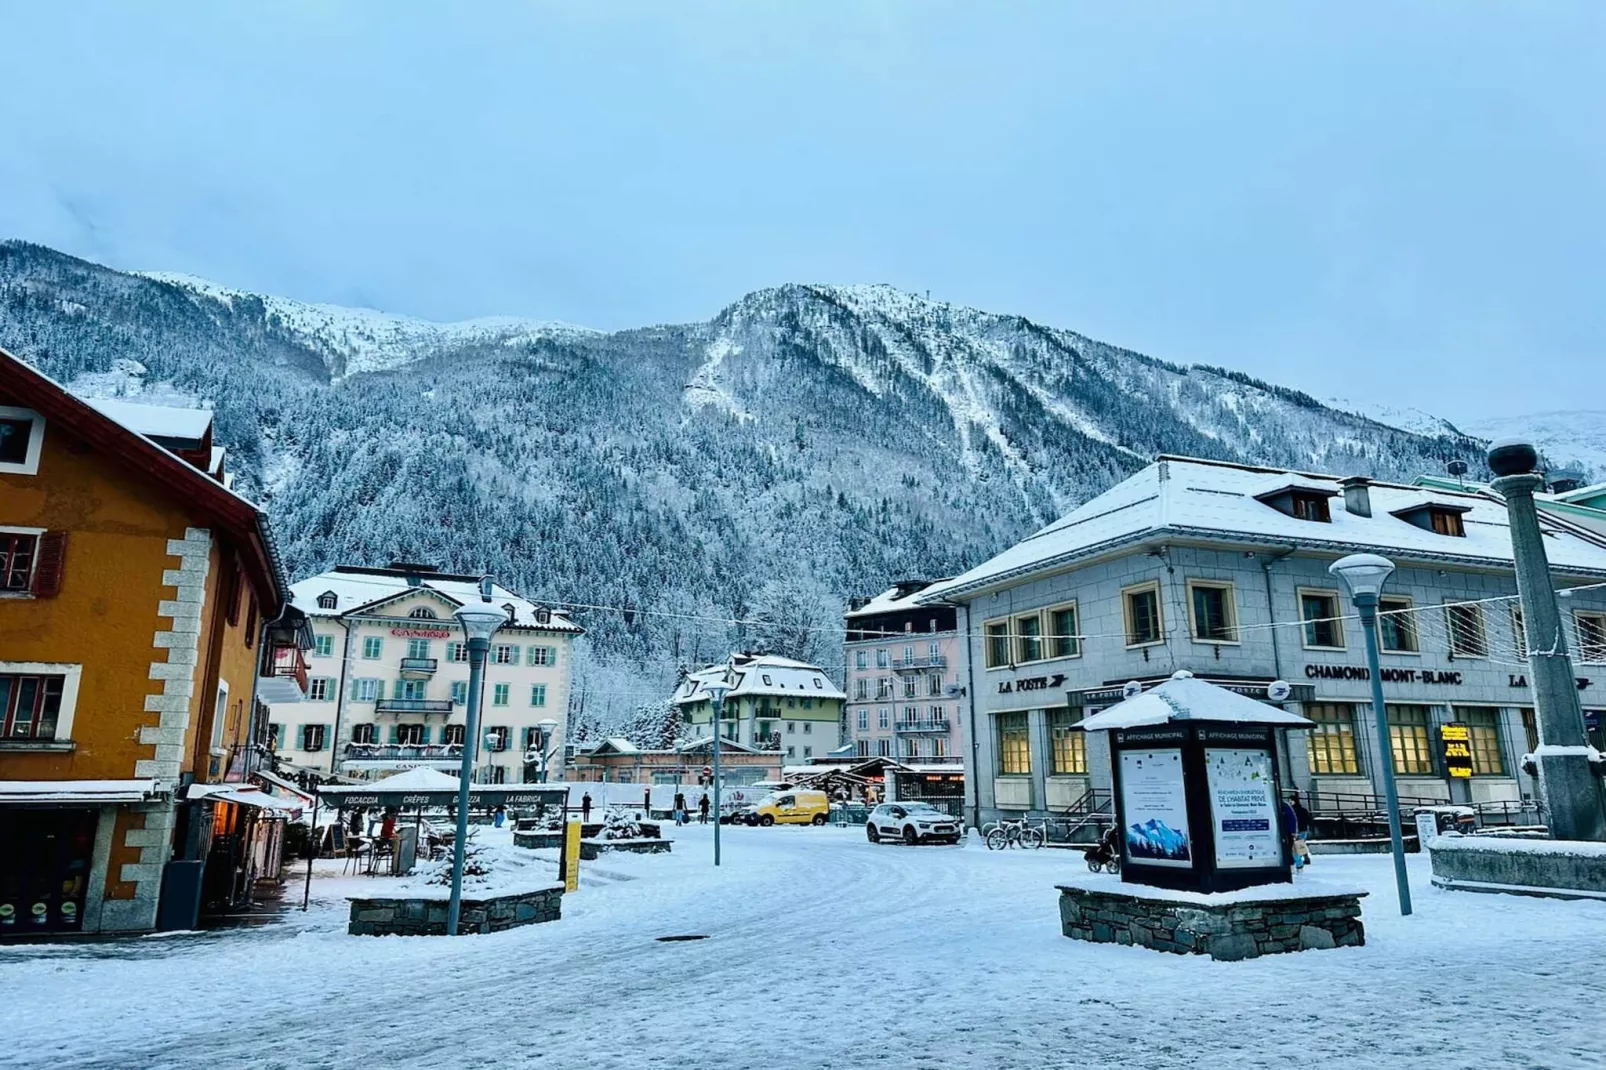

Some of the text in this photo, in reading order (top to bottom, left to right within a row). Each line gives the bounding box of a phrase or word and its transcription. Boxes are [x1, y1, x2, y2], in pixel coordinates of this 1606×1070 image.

[1380, 668, 1462, 685] MONT-BLANC
[1508, 674, 1527, 687] LA
[998, 677, 1047, 693] LA POSTE
[344, 796, 379, 804] FOCACCIA
